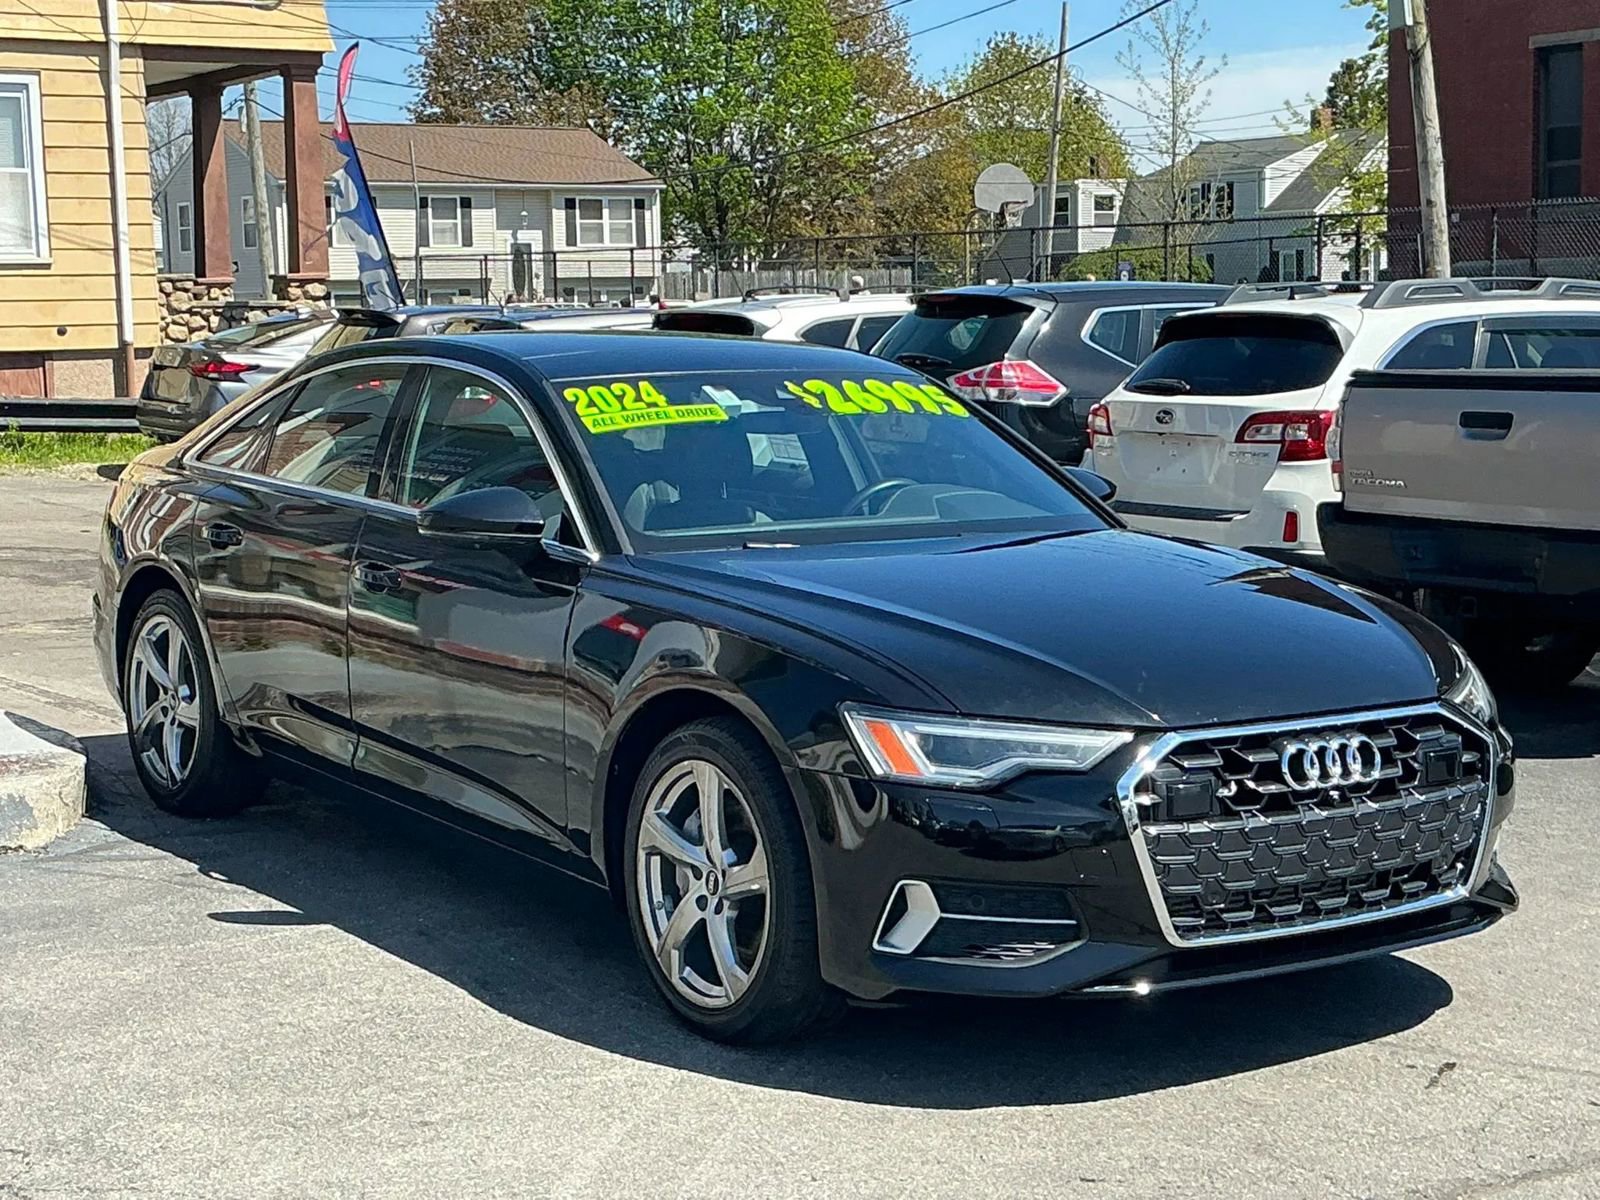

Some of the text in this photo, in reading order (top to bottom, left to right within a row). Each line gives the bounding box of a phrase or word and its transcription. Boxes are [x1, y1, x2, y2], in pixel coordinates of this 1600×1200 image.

[563, 381, 668, 416] 2024
[784, 379, 971, 418] $26995
[592, 406, 720, 429] ALL WHEEL DRIVE
